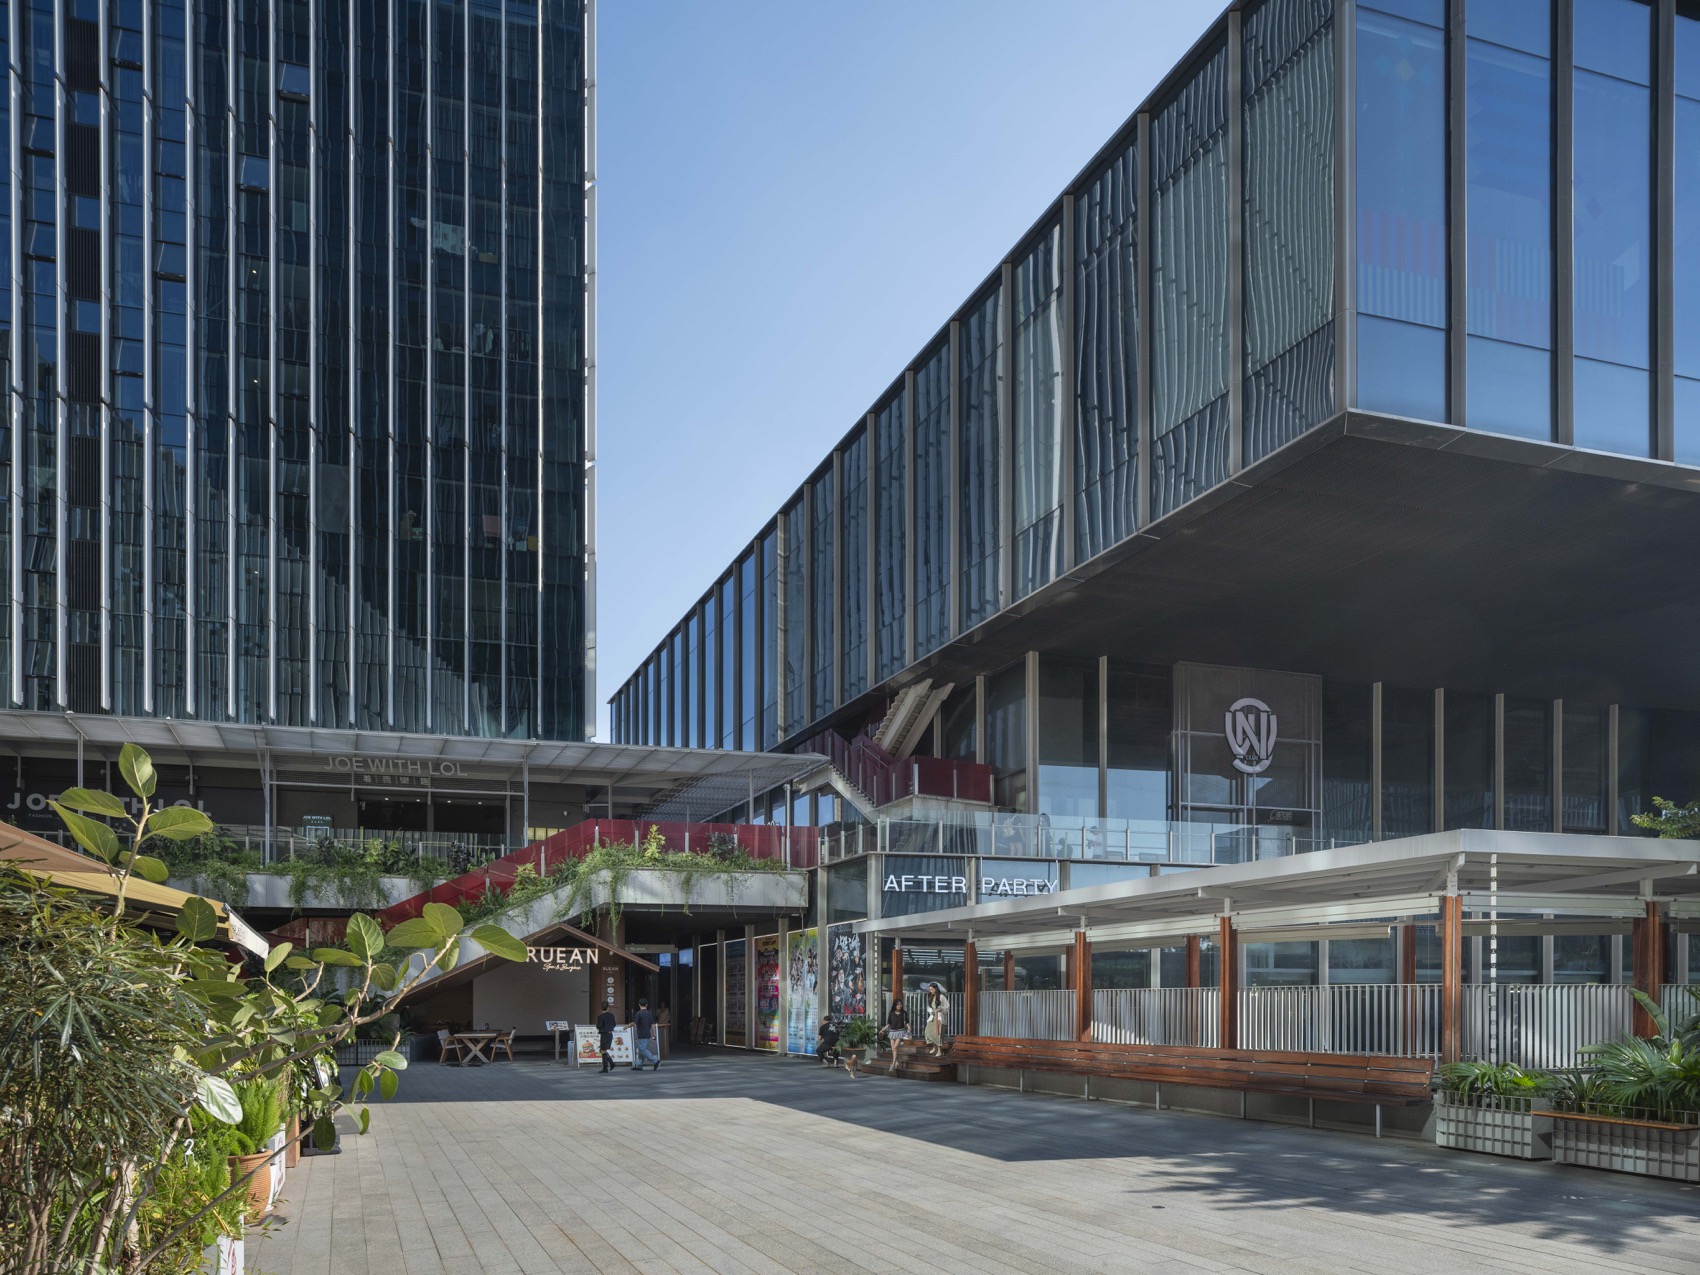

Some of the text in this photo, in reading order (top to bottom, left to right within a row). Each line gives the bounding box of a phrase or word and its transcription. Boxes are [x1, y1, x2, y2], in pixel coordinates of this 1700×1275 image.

[324, 756, 468, 776] JOE WITH LOL
[884, 874, 1058, 895] AFTER PARTY
[526, 946, 599, 964] RUEAN
